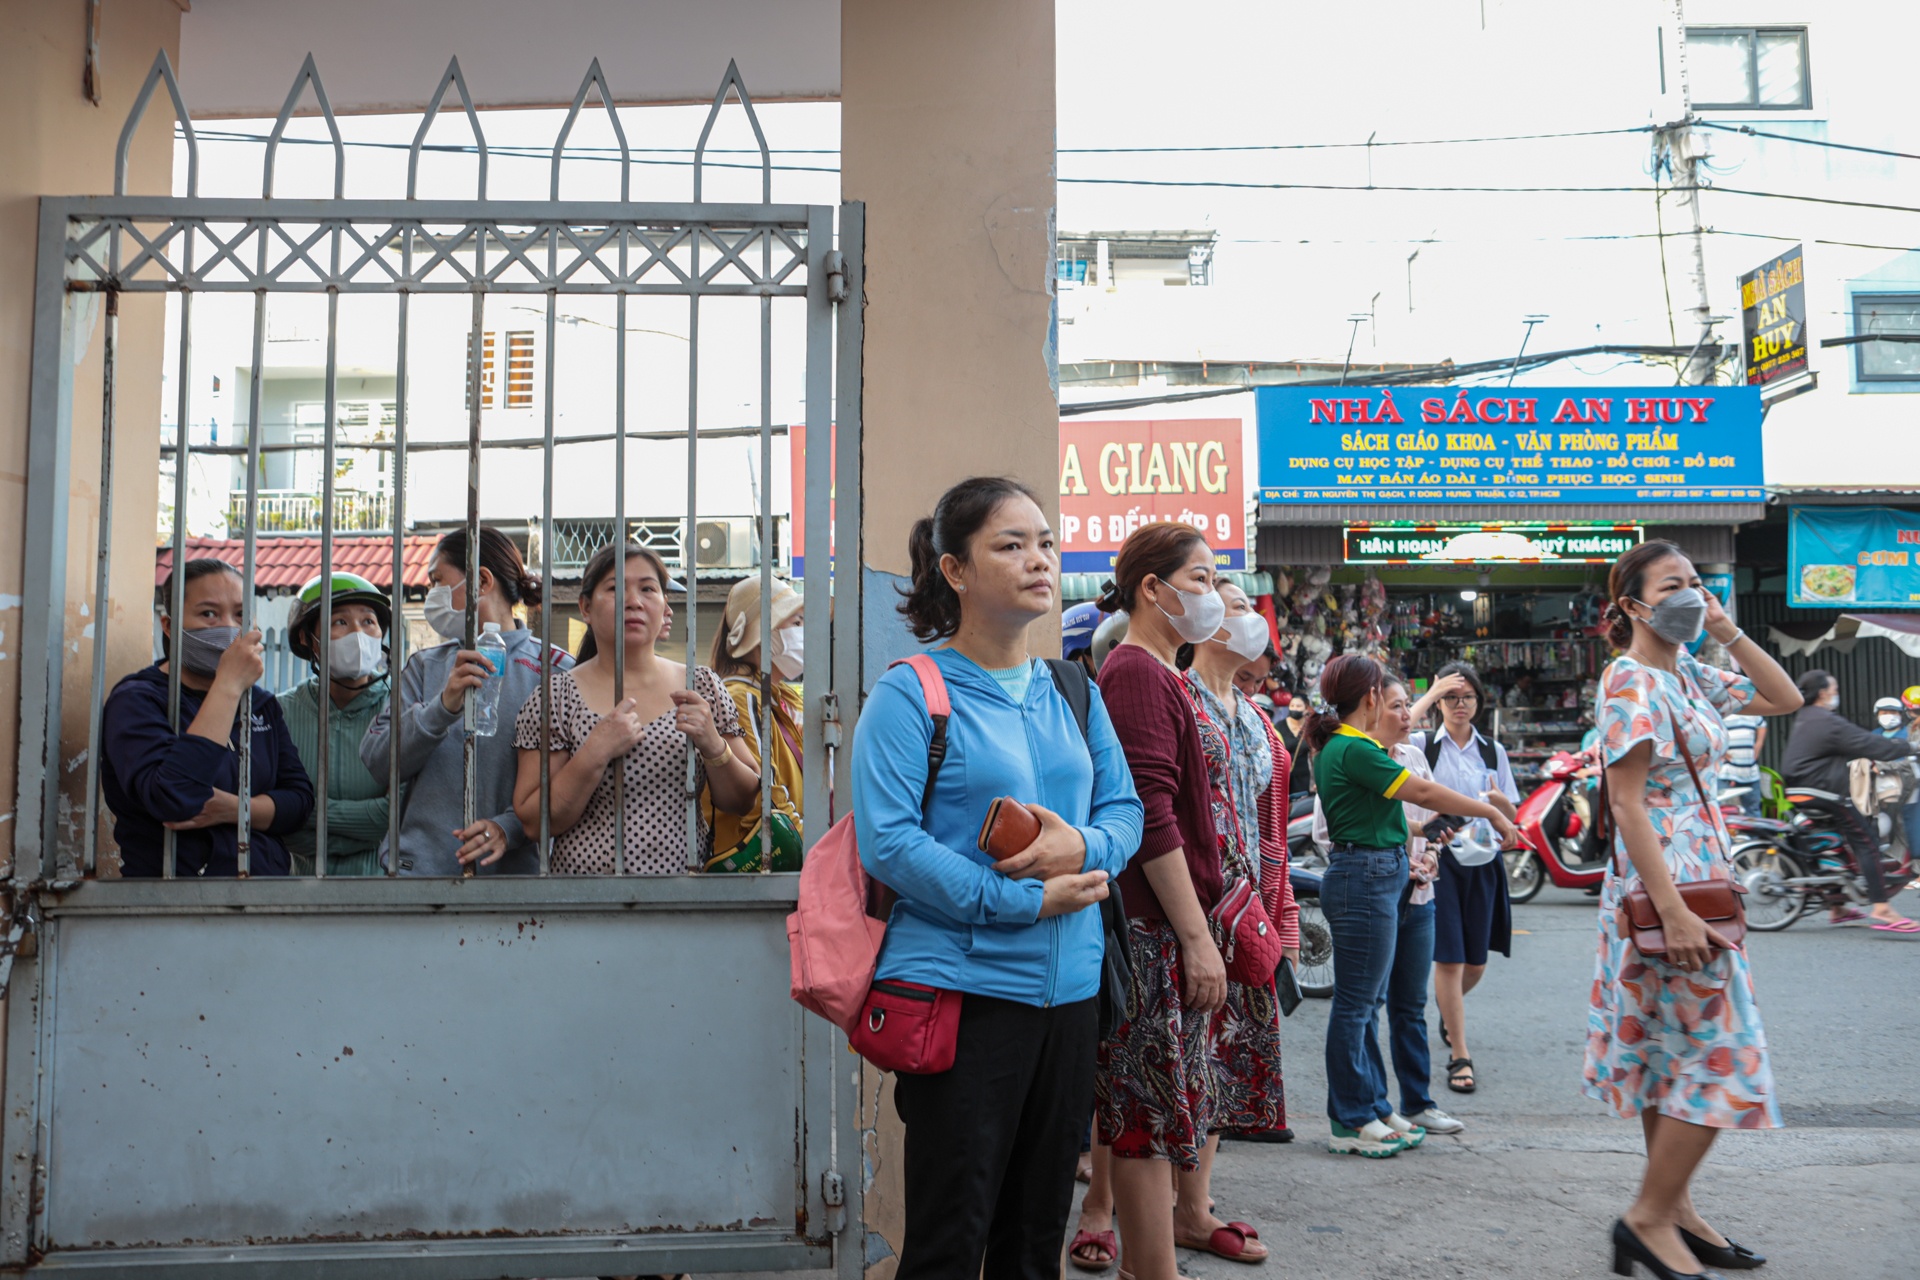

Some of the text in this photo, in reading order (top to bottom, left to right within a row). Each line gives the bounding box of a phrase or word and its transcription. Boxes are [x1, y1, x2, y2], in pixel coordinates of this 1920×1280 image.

[1741, 256, 1803, 310] NHÀ SÁCH
[1758, 293, 1787, 330] AN
[1752, 321, 1796, 363] HUY
[1309, 389, 1715, 424] NHÀ SÁCH AN HUY
[1341, 429, 1390, 451] SÁCH
[1396, 429, 1439, 451] GIÁO
[1446, 433, 1496, 451] KHOA
[1515, 430, 1553, 451] VĂN
[1559, 429, 1619, 451] PHÒNG
[1626, 426, 1679, 451] PHẨM
[1099, 441, 1228, 495] GIANG
[1289, 457, 1330, 470] DỤNG
[1334, 457, 1354, 470] CỤ
[1358, 457, 1390, 470] HỌC
[1394, 455, 1425, 470] TẬP
[1439, 457, 1481, 470] DỤNG
[1484, 457, 1505, 470] CỤ
[1550, 457, 1593, 468] THAO
[1632, 456, 1671, 468] CHƠI
[1709, 456, 1736, 468] BƠI
[1337, 474, 1374, 485] MAY
[1379, 472, 1414, 485] BÁN
[1418, 472, 1442, 485] ÁO
[1446, 472, 1477, 485] DÀI
[1547, 474, 1594, 486] PHỤC
[1601, 474, 1636, 486] HỌC
[1644, 474, 1686, 485] SINH
[1087, 515, 1102, 543] 6
[1216, 513, 1231, 541] 9
[1360, 537, 1395, 554] HÂN
[1857, 550, 1909, 566] CƠM
